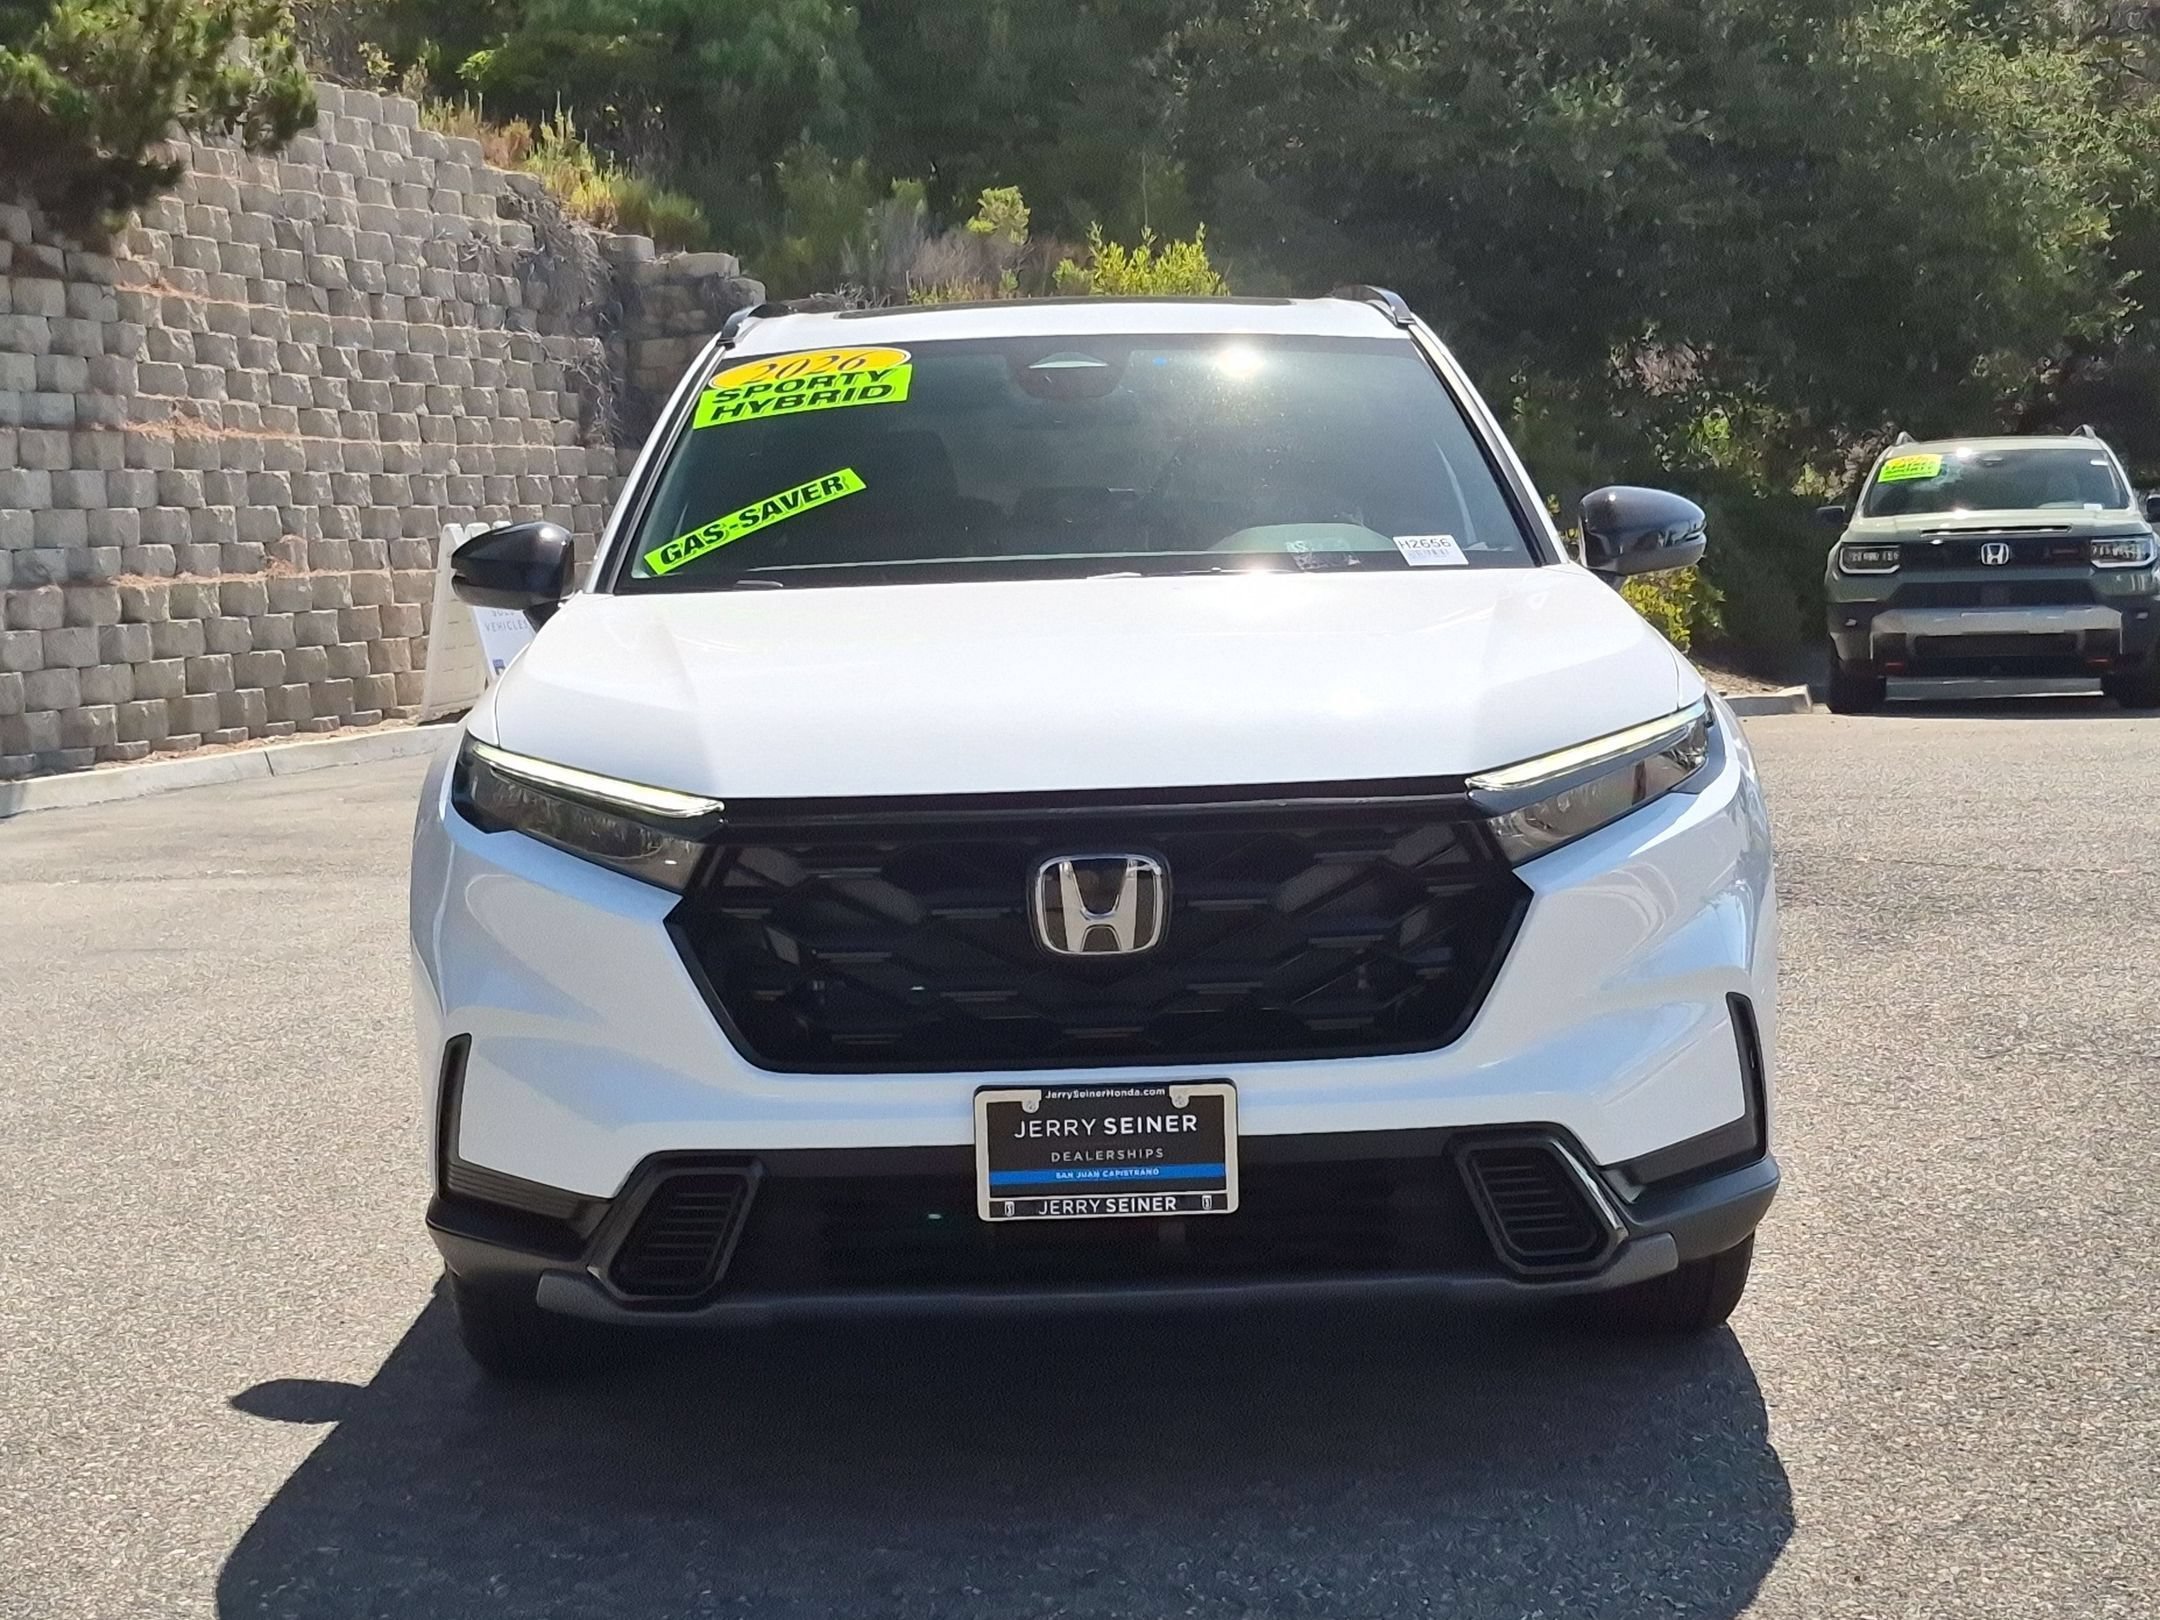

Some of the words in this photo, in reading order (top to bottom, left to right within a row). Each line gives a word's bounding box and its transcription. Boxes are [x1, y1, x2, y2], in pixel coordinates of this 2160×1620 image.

[743, 350, 875, 385] 2026
[712, 367, 893, 403] SPORTY
[710, 384, 893, 421] HYBRID
[660, 475, 848, 567] GAS-SAVER
[1398, 538, 1452, 550] H2656
[484, 619, 529, 632] VEHICLES
[1045, 1087, 1166, 1100] JerrySeinerHonda.com
[1014, 1118, 1096, 1139] JERRY
[1103, 1114, 1198, 1135] SEINER
[1051, 1147, 1164, 1163] DEALERSHIPS
[1055, 1170, 1074, 1179] SAN
[1076, 1169, 1100, 1179] JUAN
[1102, 1168, 1160, 1178] CAPISTRANO
[1039, 1200, 1099, 1216] JERRY
[1105, 1196, 1177, 1213] SEINER
